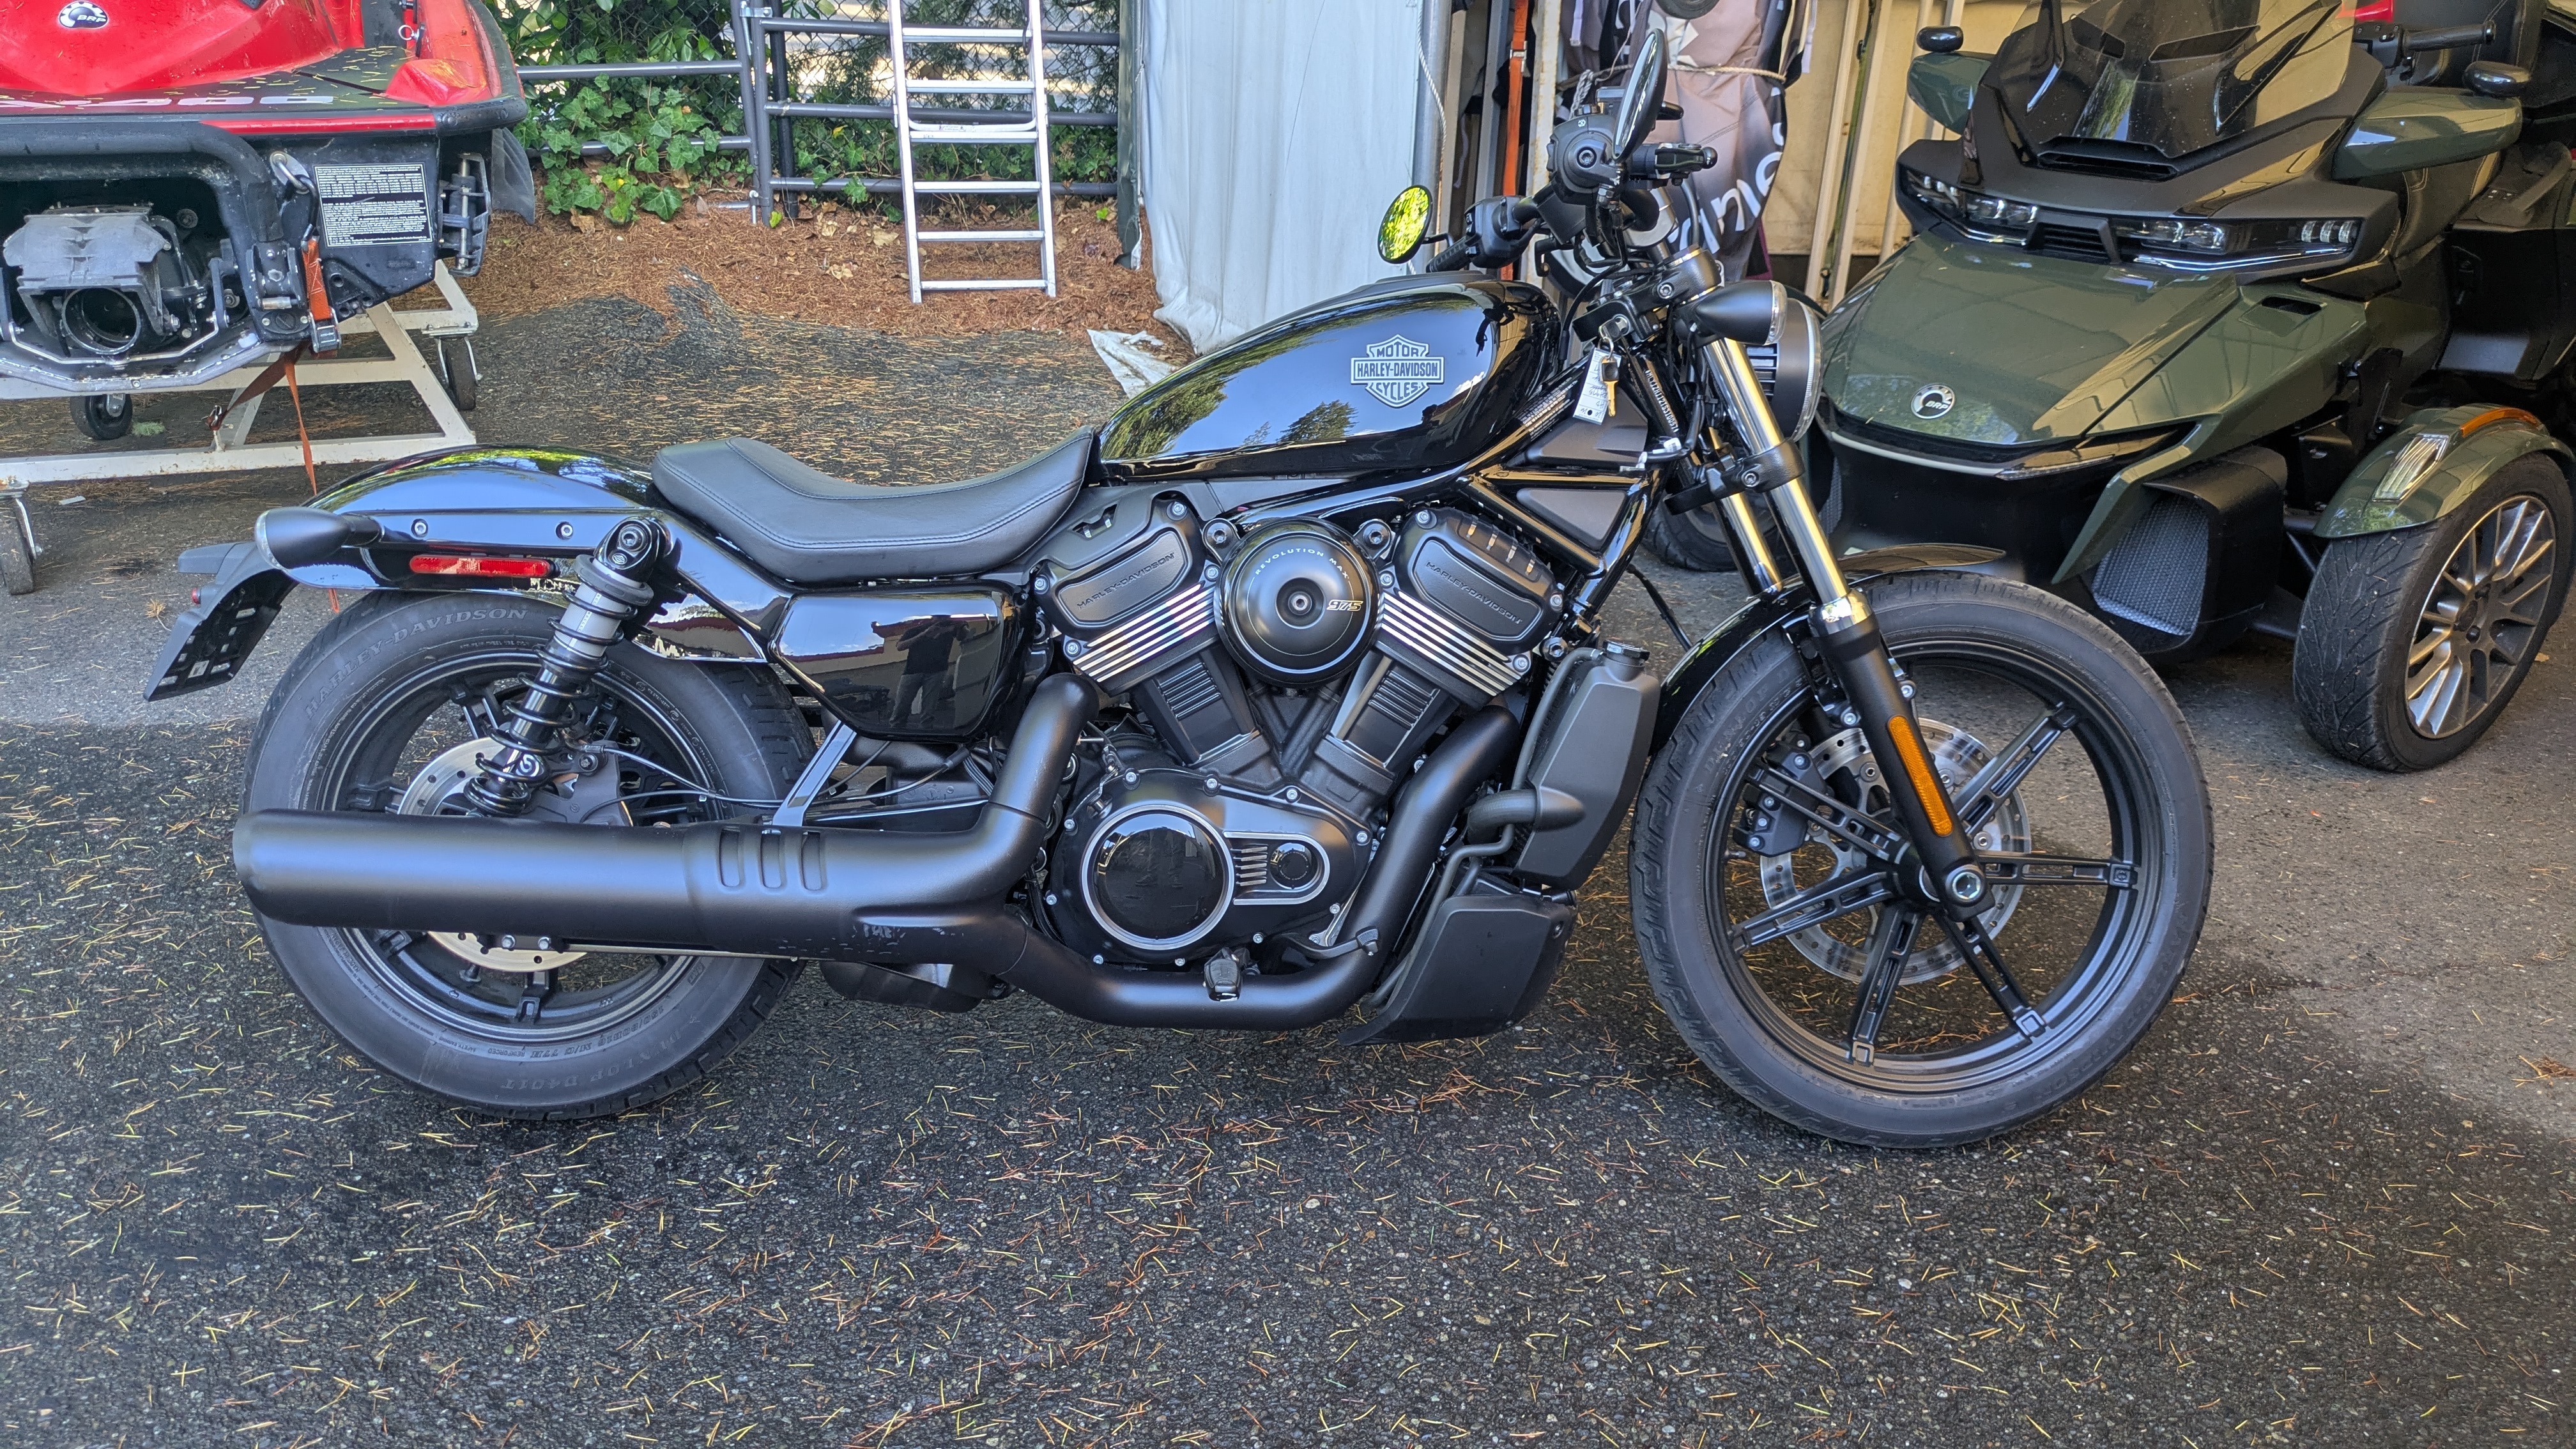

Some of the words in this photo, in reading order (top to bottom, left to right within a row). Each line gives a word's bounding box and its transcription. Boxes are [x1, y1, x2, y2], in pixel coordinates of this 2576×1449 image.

[77, 14, 107, 22] BRP
[1377, 341, 1419, 357] MOTOR
[1357, 362, 1438, 377] HARLEY-DAVIDSON
[1925, 401, 1949, 410] BRP
[1255, 548, 1324, 575] REVOLUTION
[1329, 558, 1348, 579] MAX
[1077, 553, 1175, 610] HARLEY-DAVIDSON
[1426, 562, 1522, 625] HARLEY-DAVIDSON
[1327, 599, 1364, 611] 975
[304, 608, 528, 719] HARLEY-DAVIDSON
[486, 1047, 525, 1057] REINFORCED
[588, 1026, 684, 1085] DUNLOP
